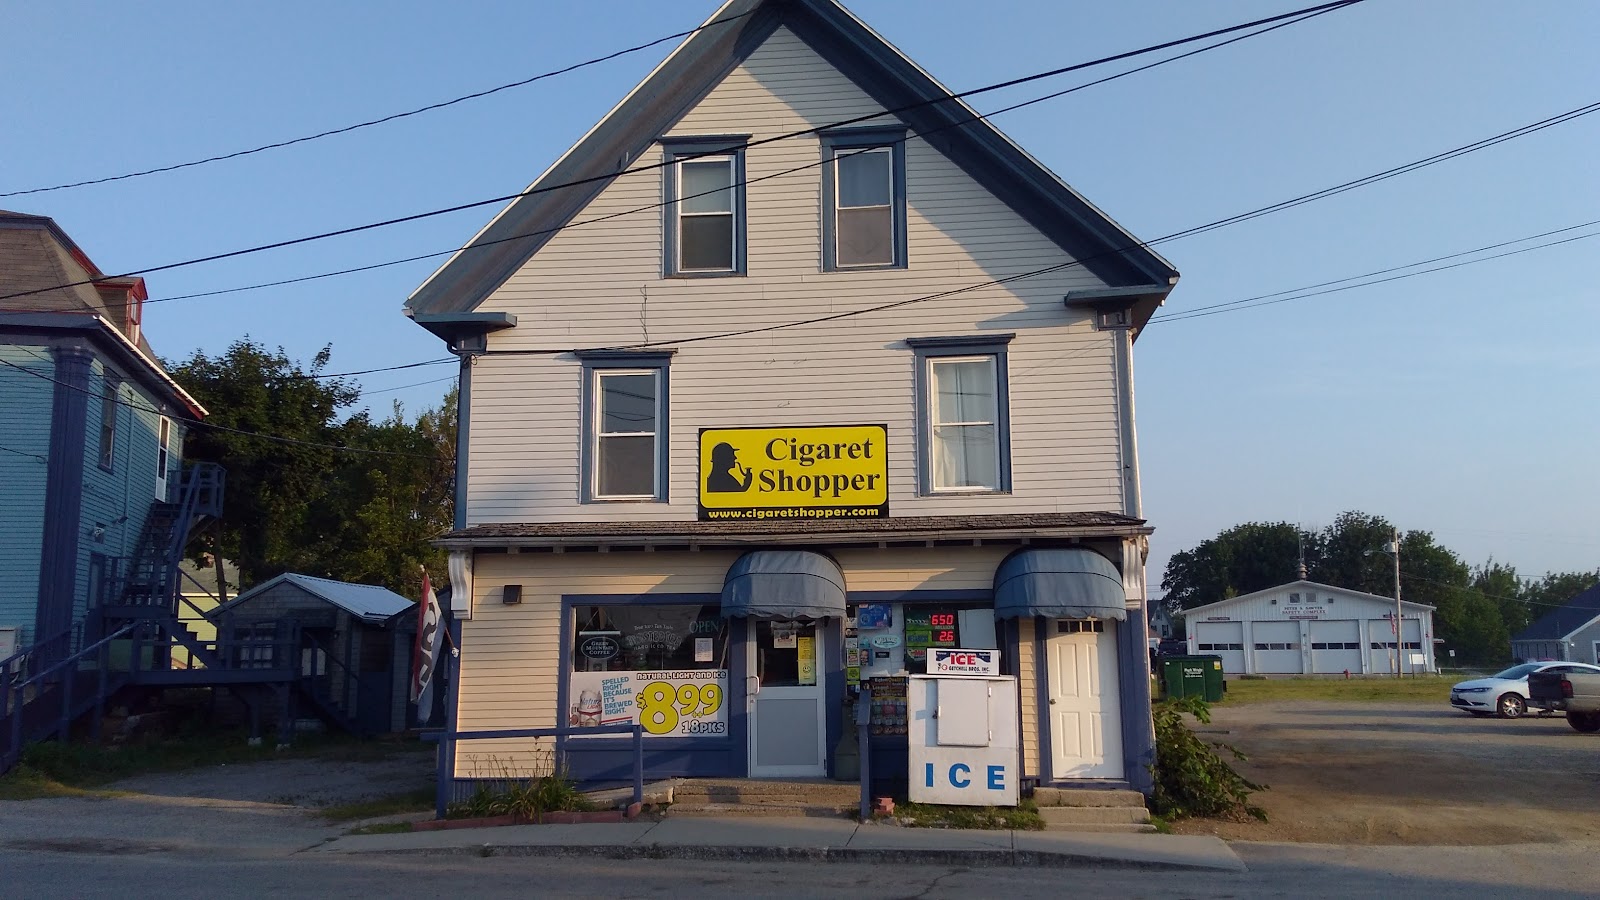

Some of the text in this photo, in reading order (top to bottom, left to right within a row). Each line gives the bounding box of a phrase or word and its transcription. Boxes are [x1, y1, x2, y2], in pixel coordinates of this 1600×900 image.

[765, 437, 873, 467] Cigaret
[759, 469, 880, 498] Shopper
[708, 507, 879, 519] www.cigaretshopper.com
[931, 614, 954, 625] 650
[688, 620, 719, 634] OPEN
[939, 631, 954, 642] 2.6
[950, 654, 977, 665] ICE
[602, 676, 629, 686] SPELLED
[672, 671, 695, 680] LIGHT
[602, 683, 623, 691] RIGHT
[603, 687, 632, 697] BECAUSE
[604, 700, 633, 709] BREWED
[605, 707, 627, 715] RIGHT.
[925, 762, 1005, 790] ICE
